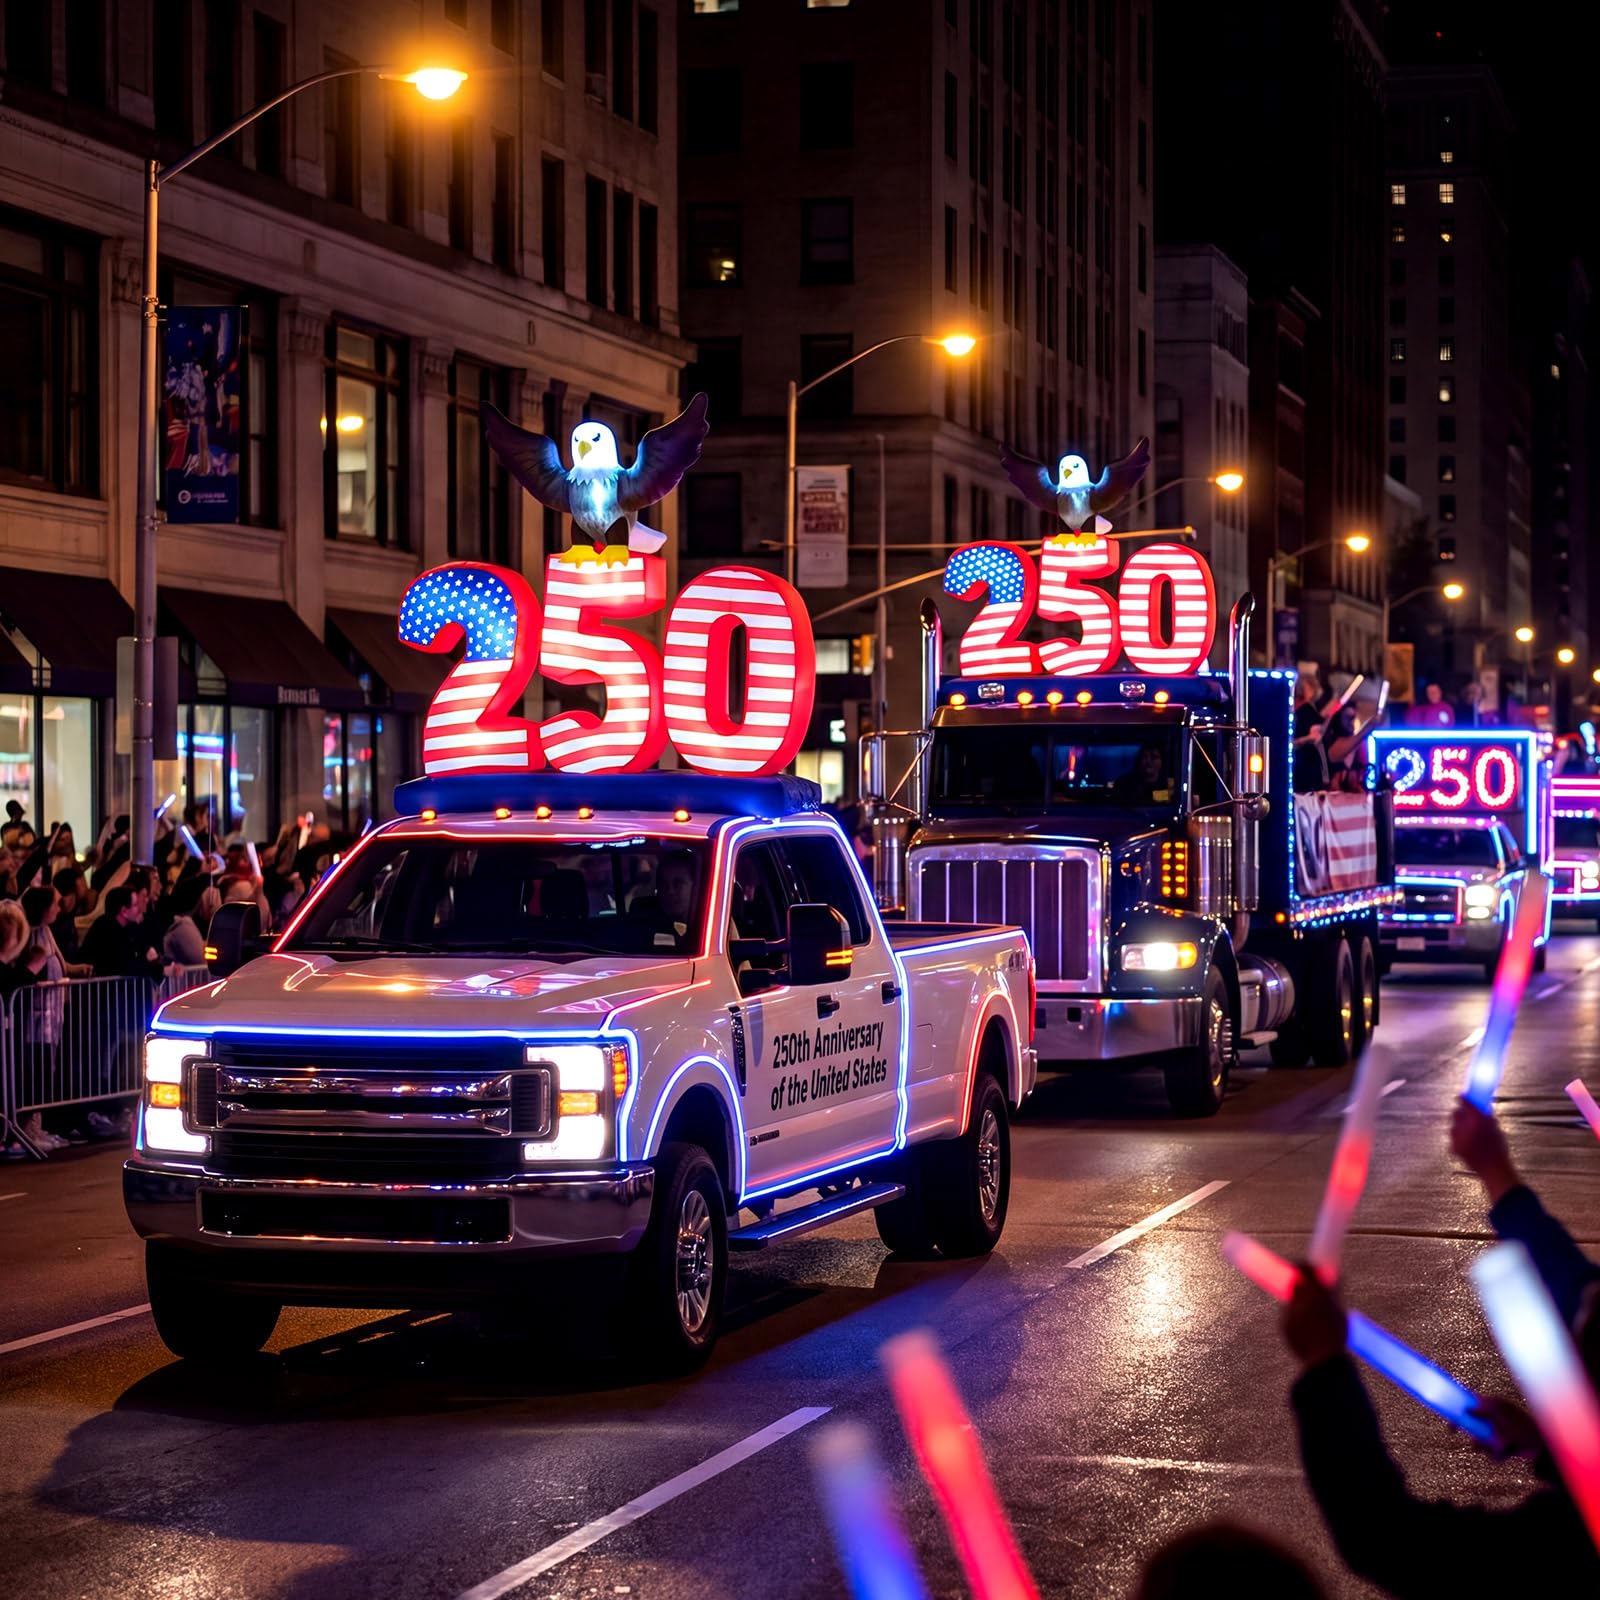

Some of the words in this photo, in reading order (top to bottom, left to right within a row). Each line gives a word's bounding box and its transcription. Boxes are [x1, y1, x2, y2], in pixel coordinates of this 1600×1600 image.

[944, 536, 1217, 677] 250
[399, 552, 816, 777] 250
[1386, 746, 1517, 807] 250
[773, 1030, 810, 1069] 250th
[813, 1021, 884, 1059] Anniversary
[771, 1076, 786, 1111] of
[788, 1073, 807, 1106] the
[811, 1061, 851, 1100] United
[852, 1056, 887, 1089] States
